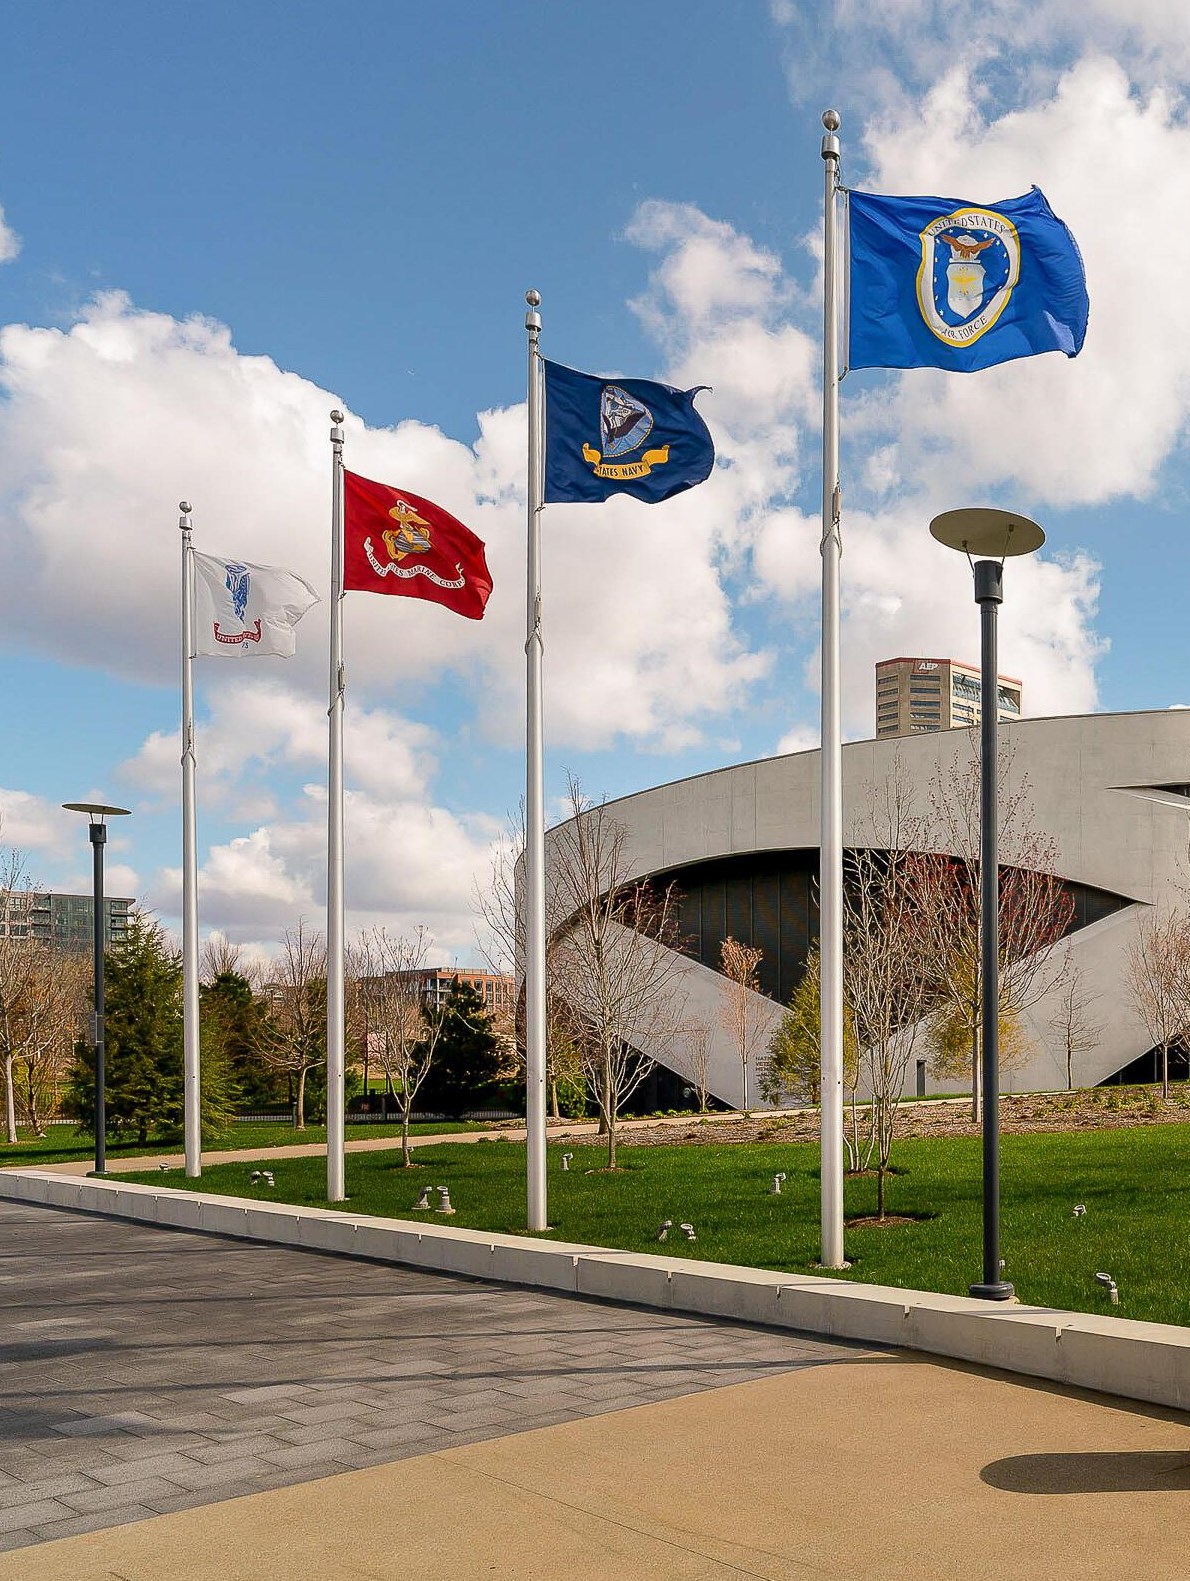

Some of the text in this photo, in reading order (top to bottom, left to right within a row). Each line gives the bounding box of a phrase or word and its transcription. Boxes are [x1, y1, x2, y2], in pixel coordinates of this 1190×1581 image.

[967, 215, 1005, 234] STATES
[958, 314, 987, 340] FORCE
[598, 464, 643, 477] TATES NAVY
[406, 565, 437, 581] MARINE
[918, 662, 939, 670] AEP
